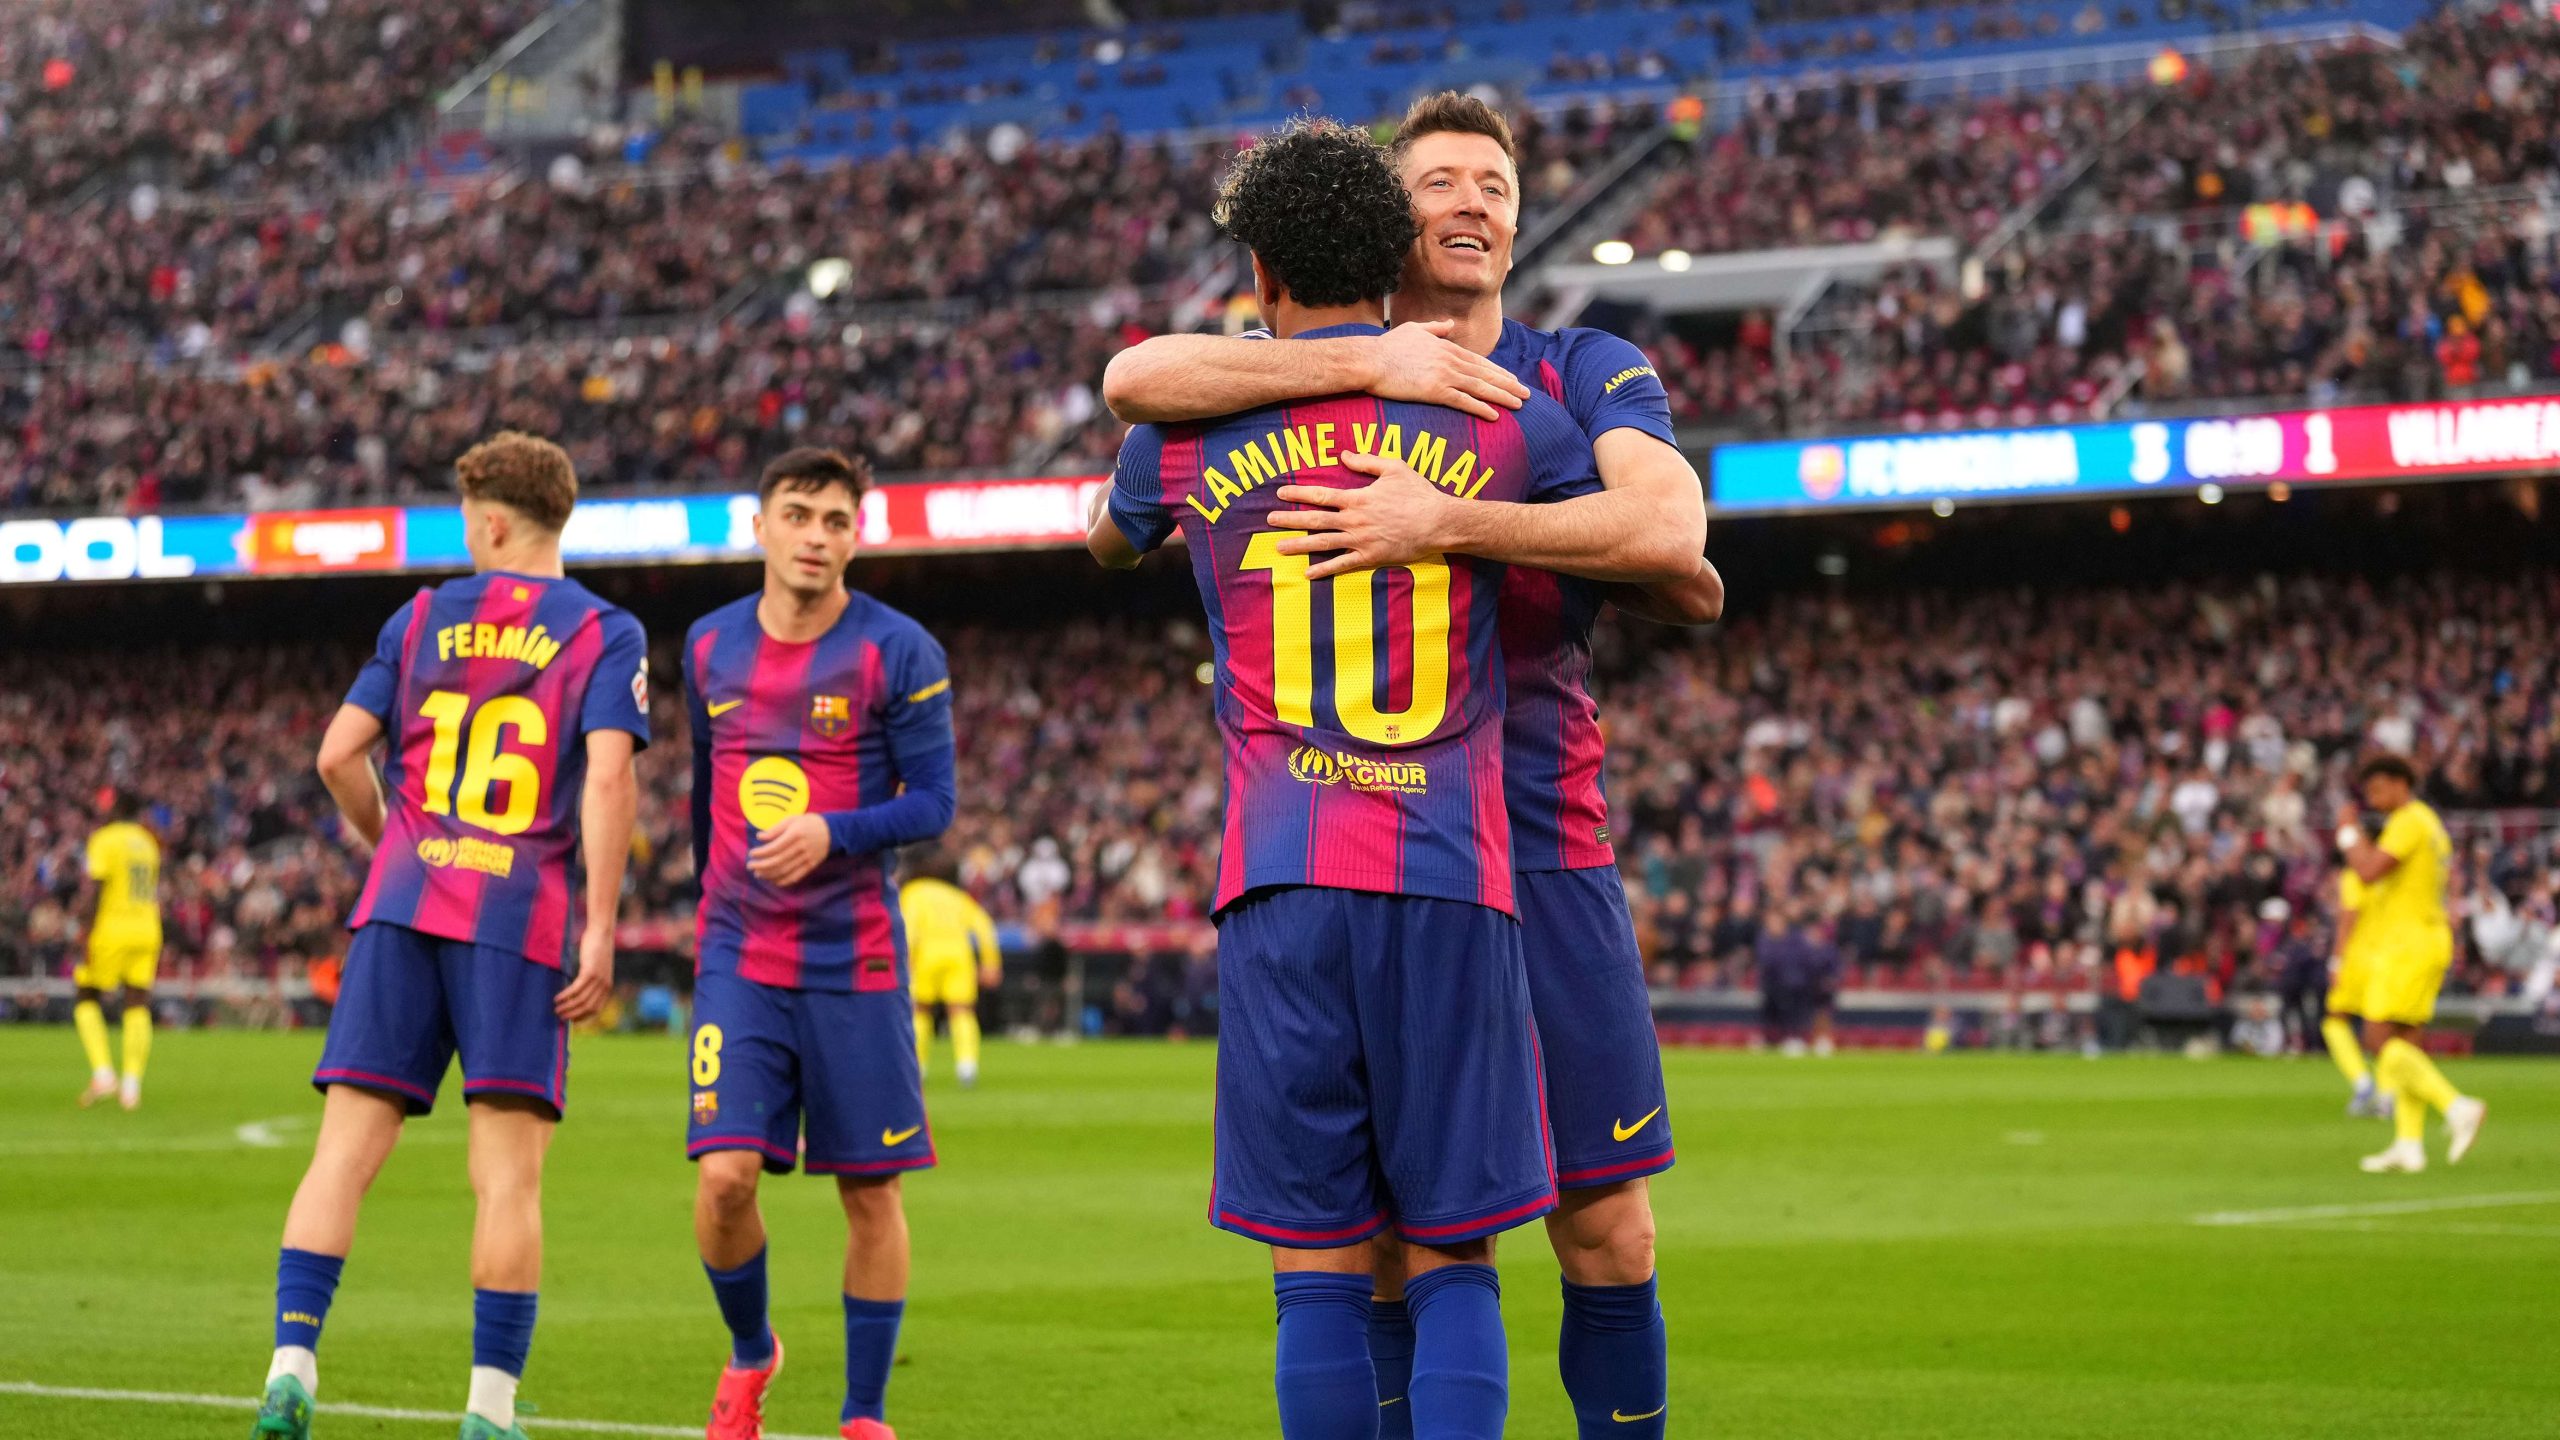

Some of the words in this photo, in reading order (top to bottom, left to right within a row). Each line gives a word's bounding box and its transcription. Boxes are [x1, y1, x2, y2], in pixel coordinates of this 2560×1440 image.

[1604, 366, 1658, 394] AMBILI
[1186, 422, 1339, 524] LAMINE
[1351, 422, 1495, 500] YAMAL
[2130, 421, 2170, 483] 3
[2303, 412, 2337, 475] 1
[0, 515, 196, 583] OOL
[437, 622, 561, 670] FERMÍN
[1239, 530, 1451, 745] 10
[418, 689, 548, 836] 16
[1370, 784, 1400, 793] Refugee
[1400, 786, 1427, 795] Agency
[692, 1023, 723, 1087] 8
